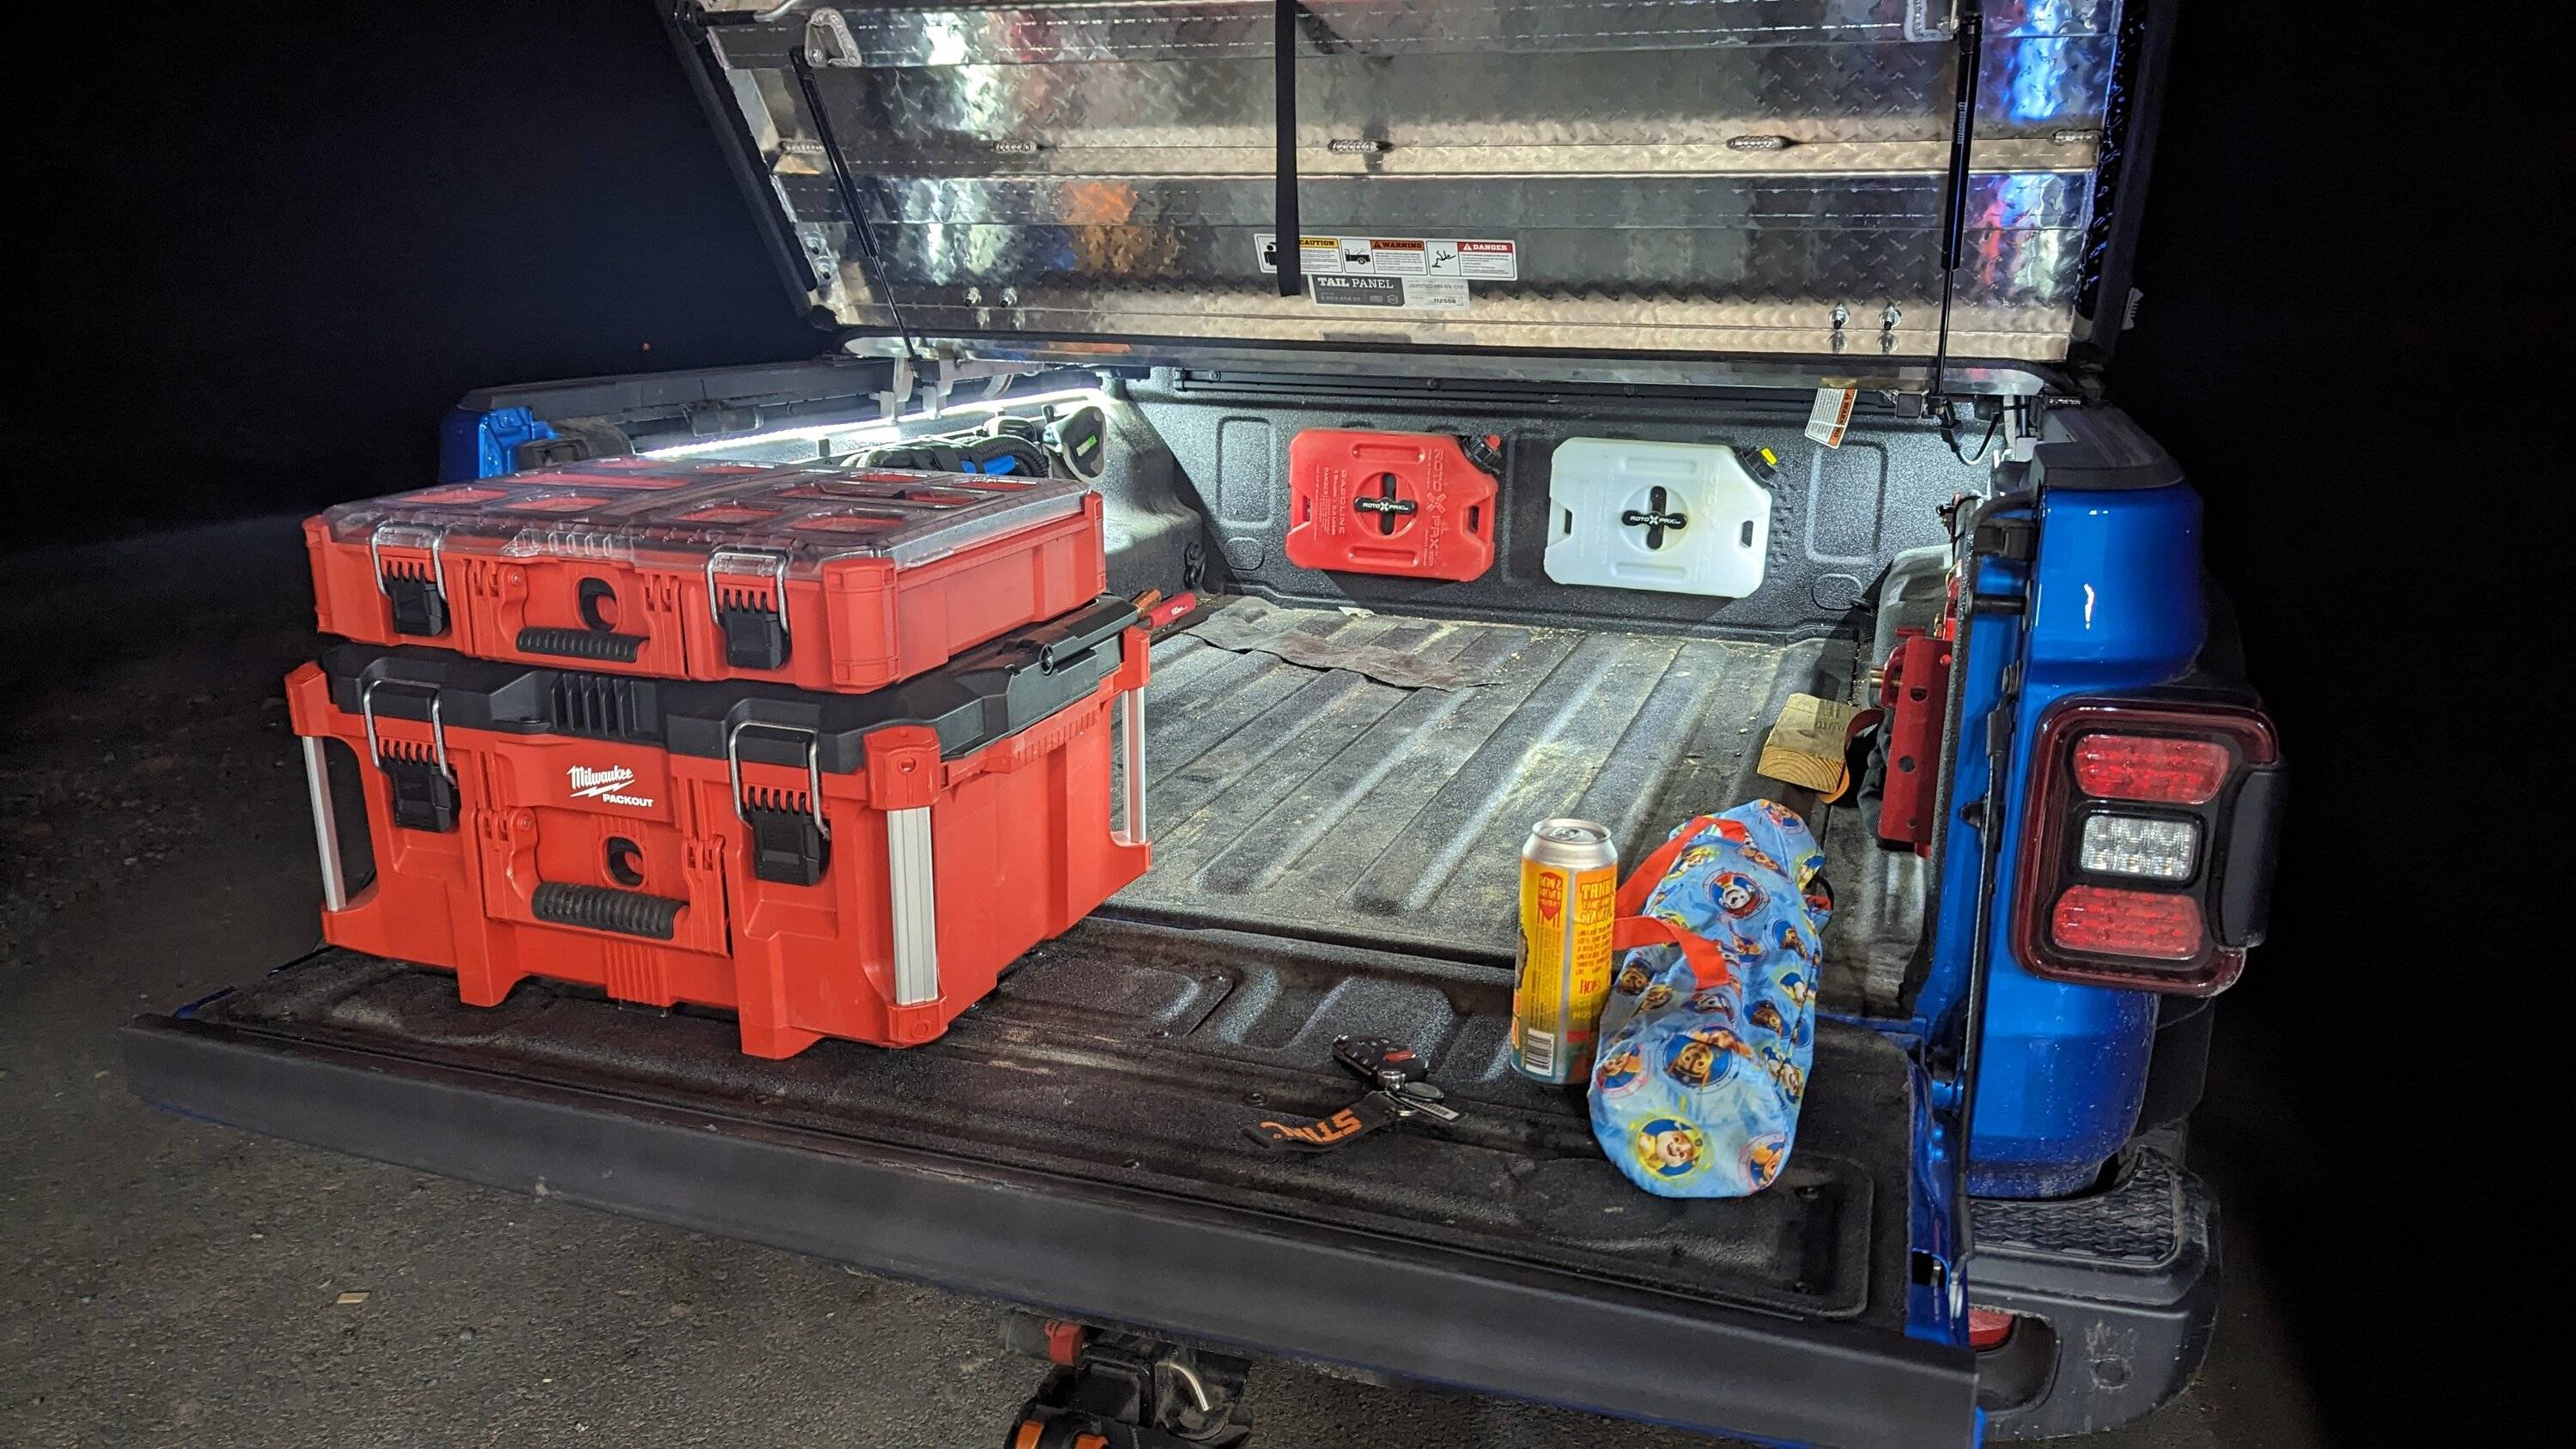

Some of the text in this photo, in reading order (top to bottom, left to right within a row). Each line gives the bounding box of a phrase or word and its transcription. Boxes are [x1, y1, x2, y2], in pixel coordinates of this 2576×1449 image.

[1317, 277, 1394, 289] TAIL PANEL
[1834, 402, 1850, 438] WARNNG
[567, 765, 634, 790] Milwaukee
[602, 793, 653, 807] PACKOUT
